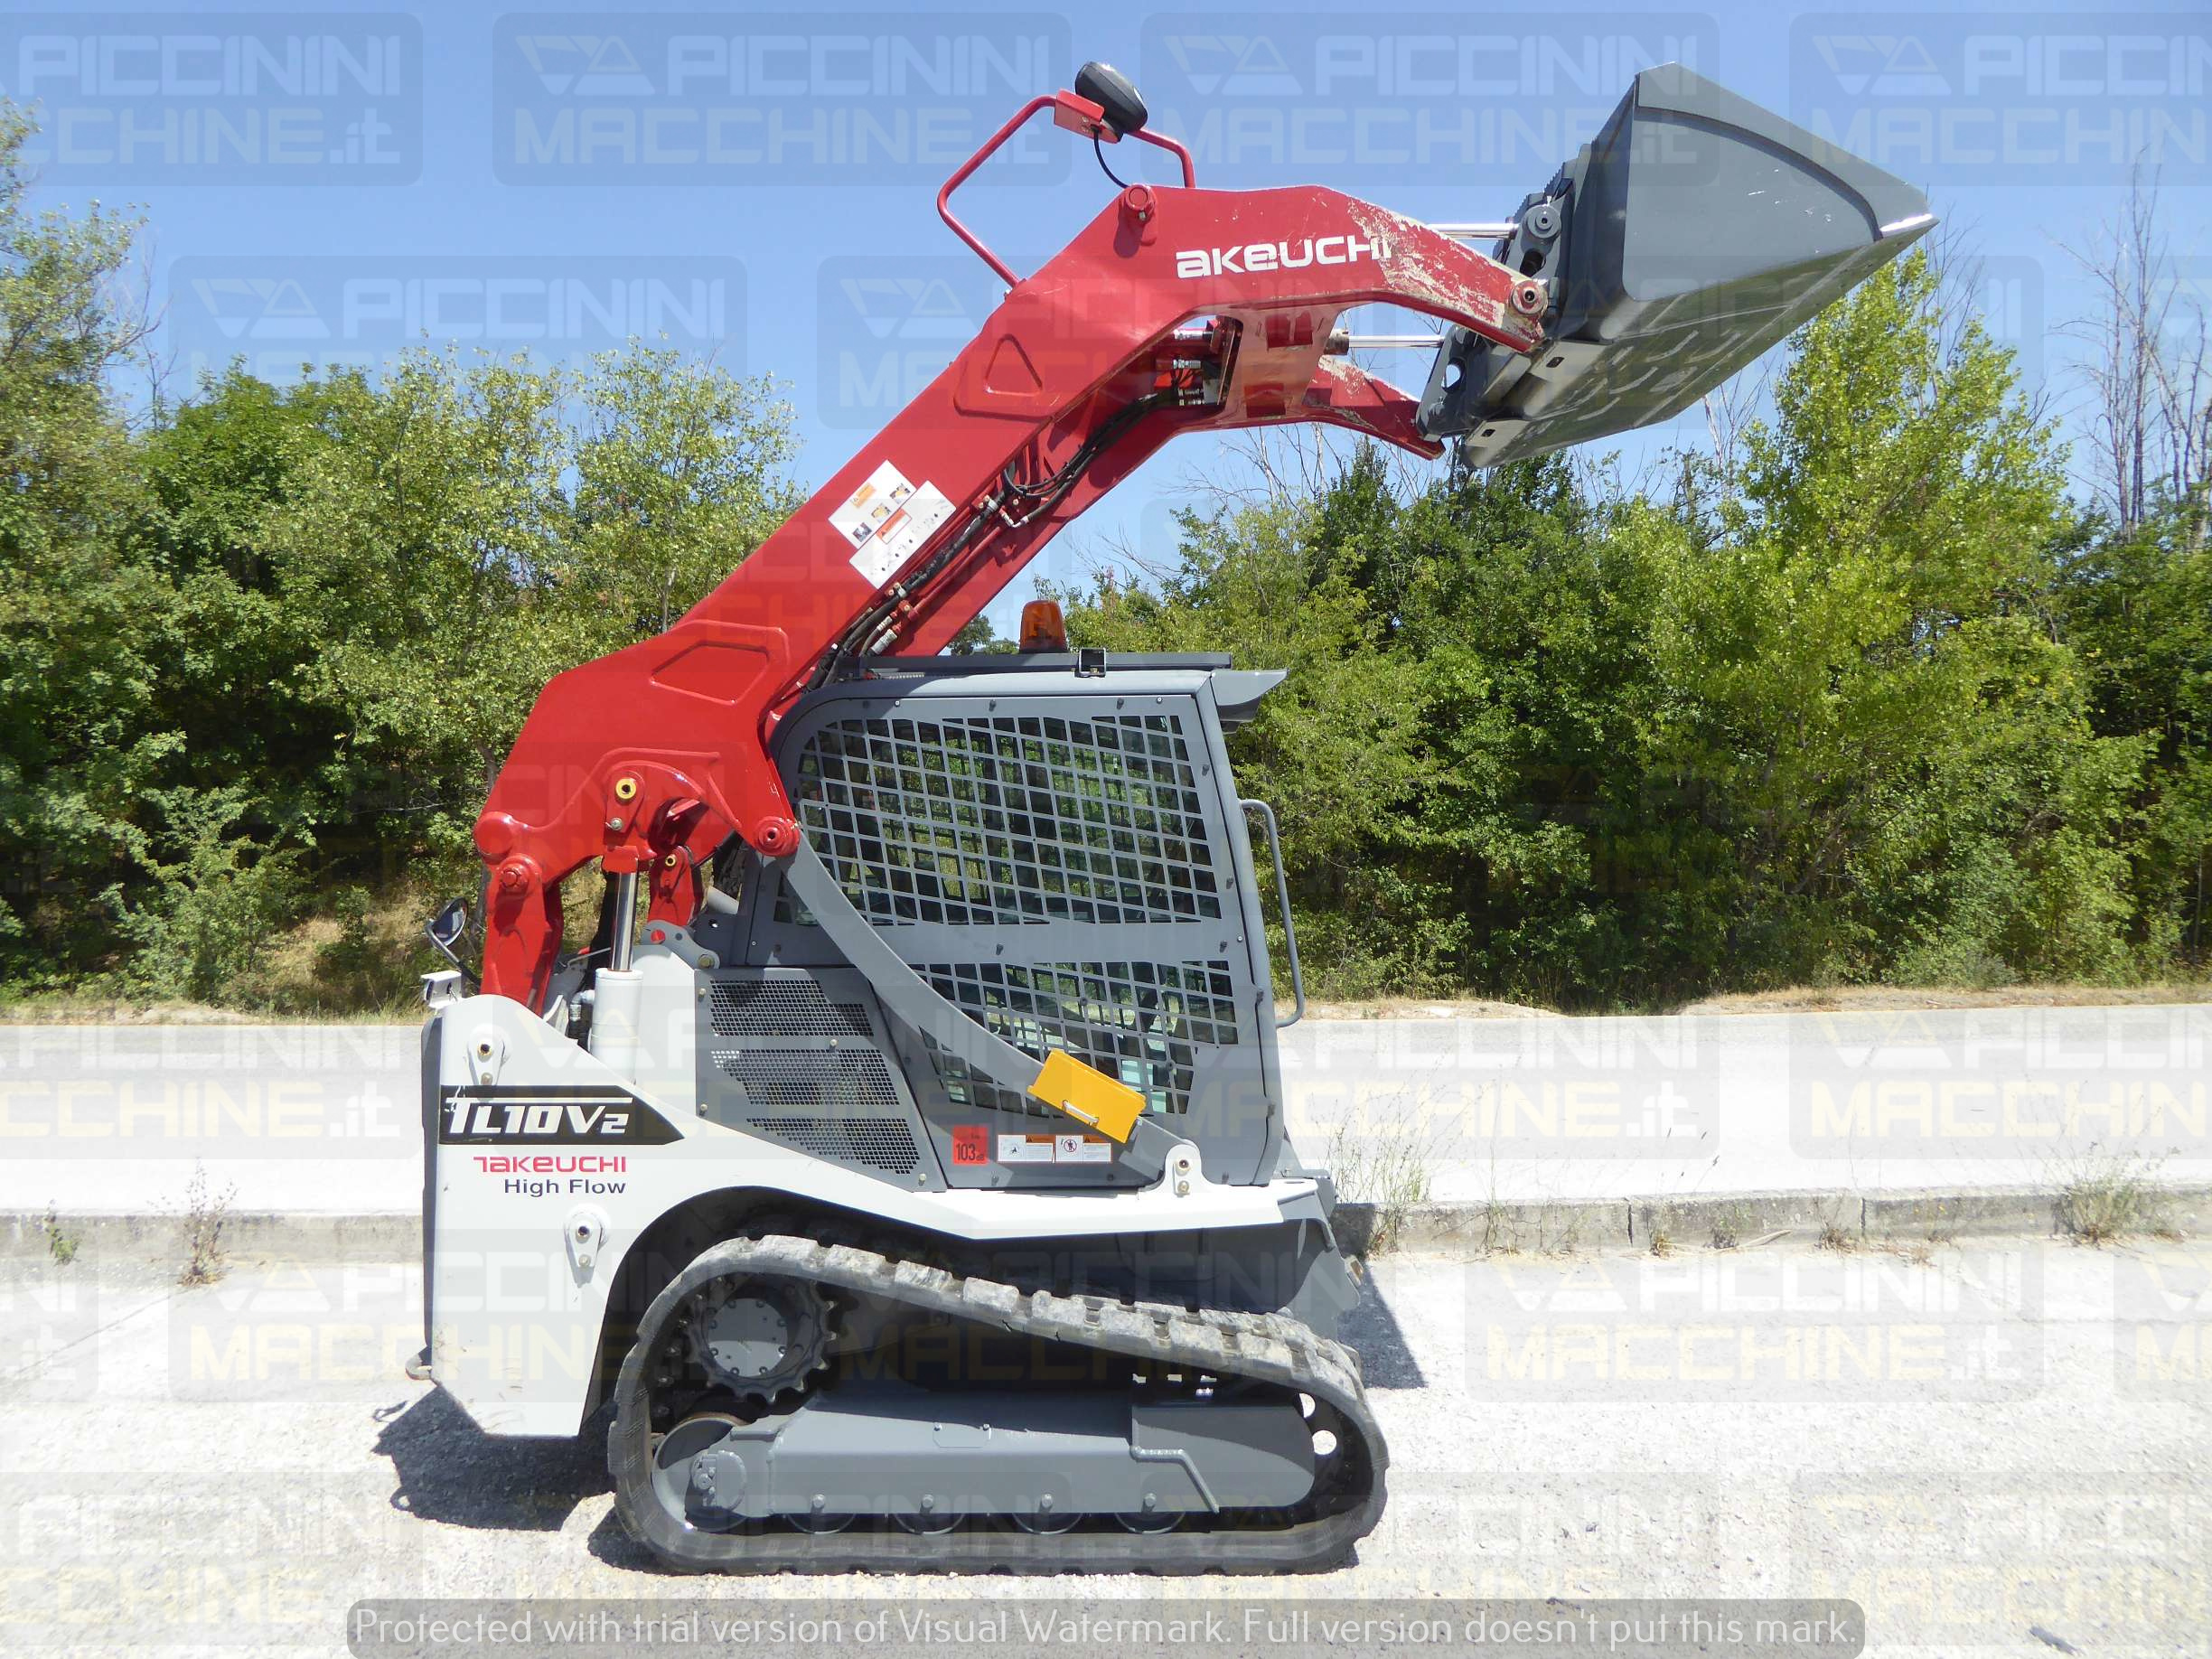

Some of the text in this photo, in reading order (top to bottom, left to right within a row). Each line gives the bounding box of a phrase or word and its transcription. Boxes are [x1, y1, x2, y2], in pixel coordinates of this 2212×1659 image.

[956, 1142, 976, 1162] 103
[504, 1179, 626, 1197] High Flow
